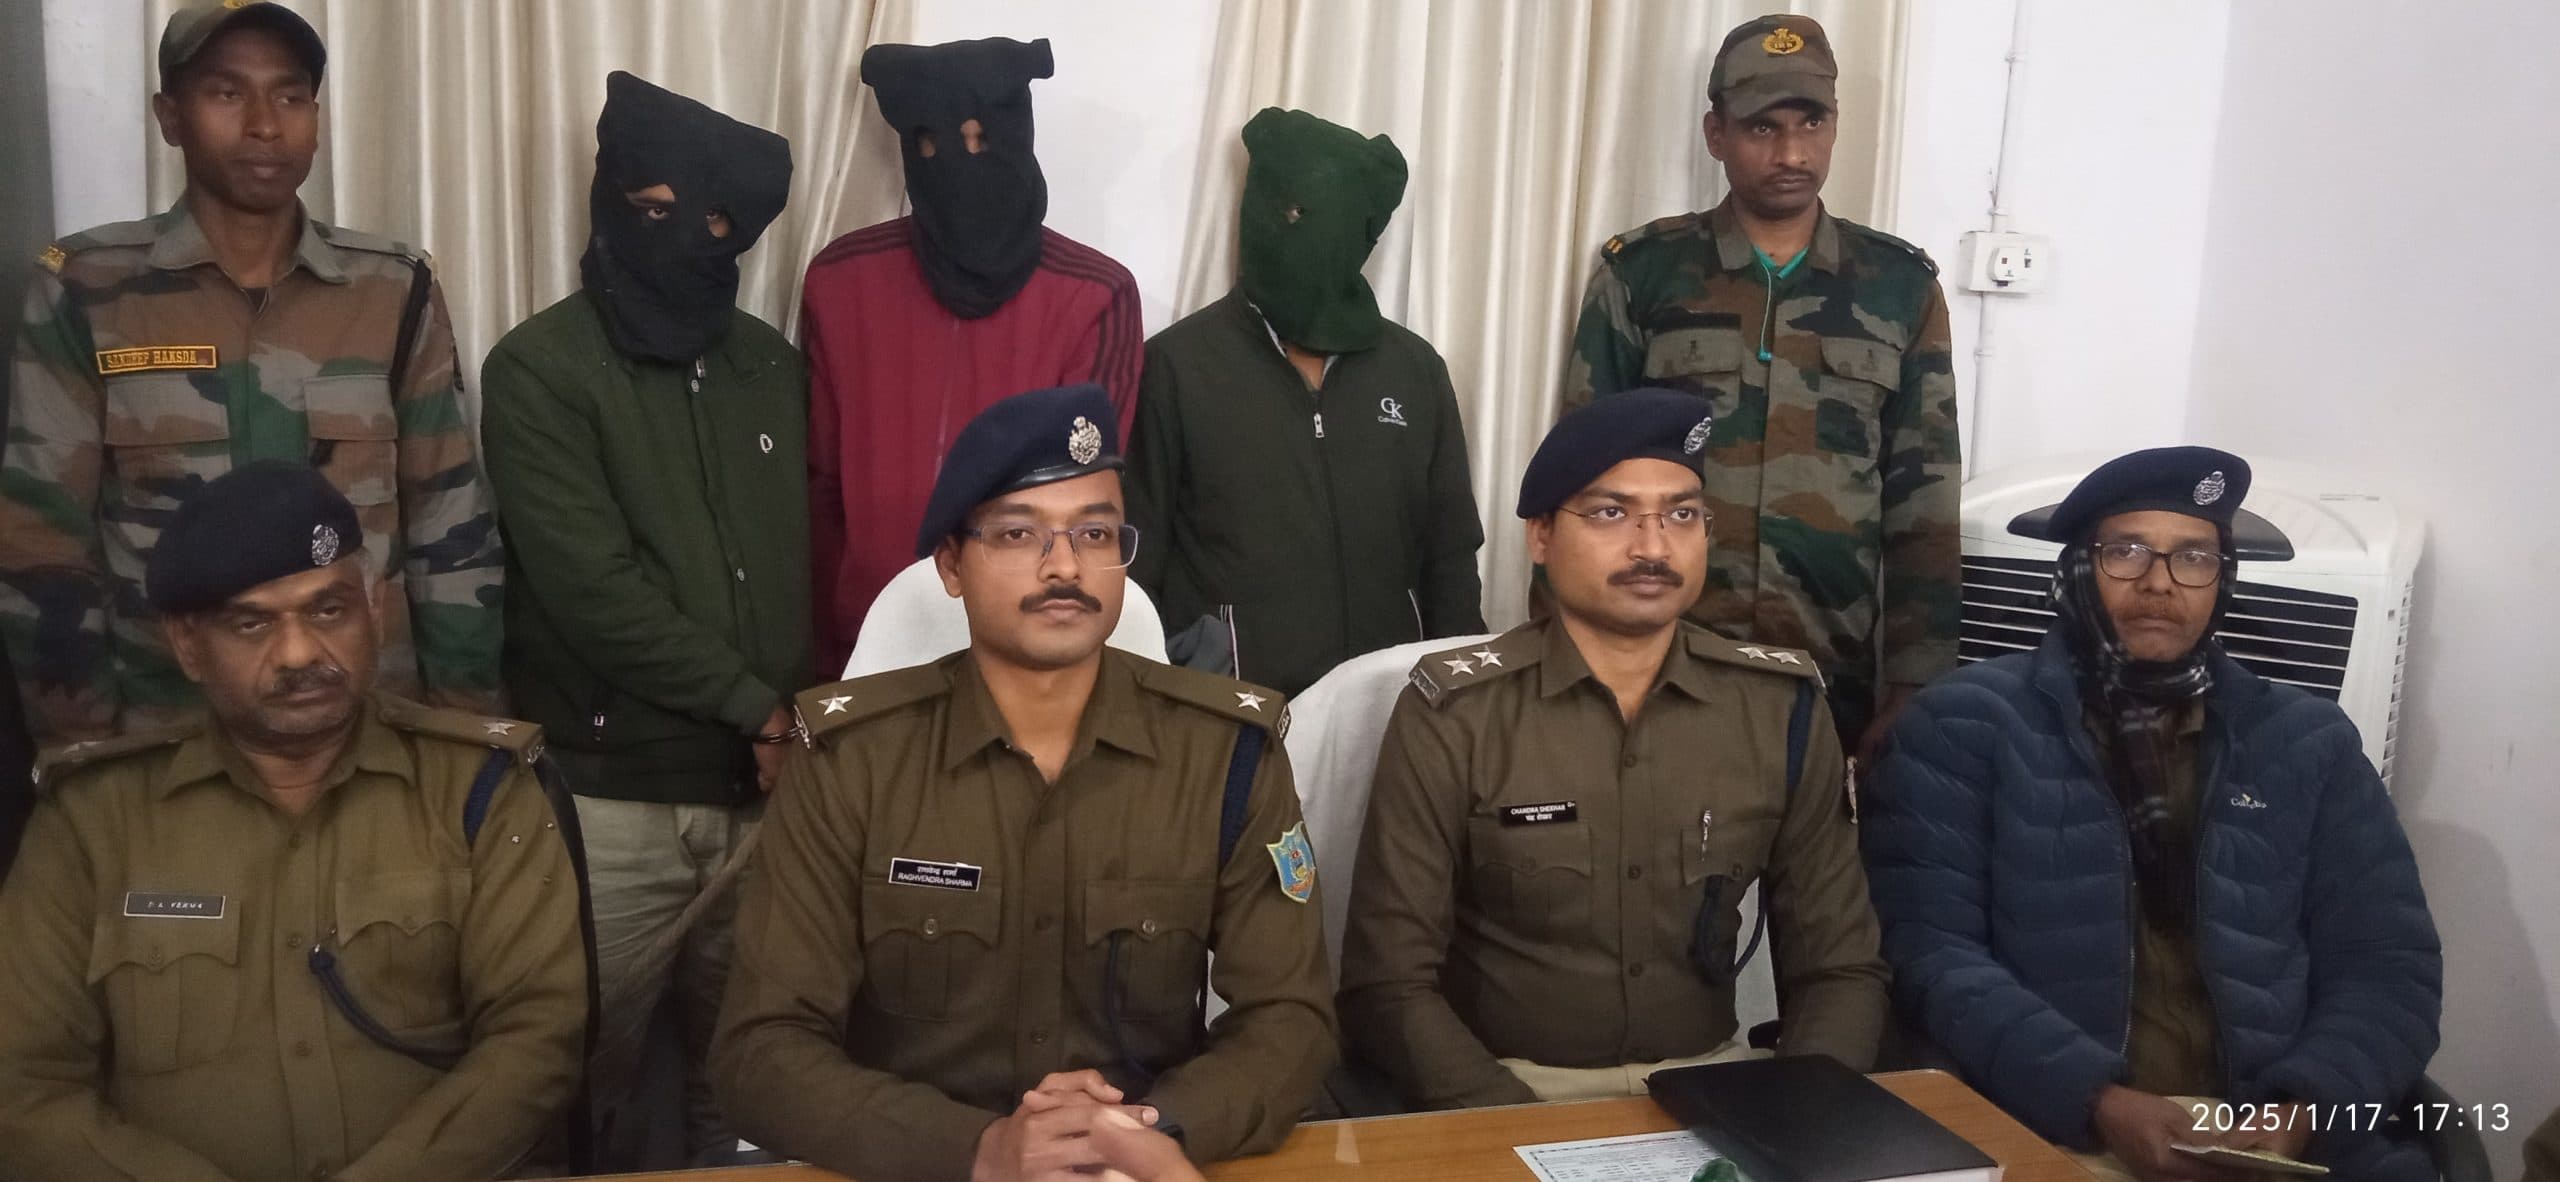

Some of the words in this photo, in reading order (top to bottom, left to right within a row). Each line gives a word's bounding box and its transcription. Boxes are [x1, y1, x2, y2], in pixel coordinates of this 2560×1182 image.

[153, 350, 198, 364] HANSDA
[897, 872, 944, 885] RAGHVENDRA
[944, 877, 973, 887] SHARMA
